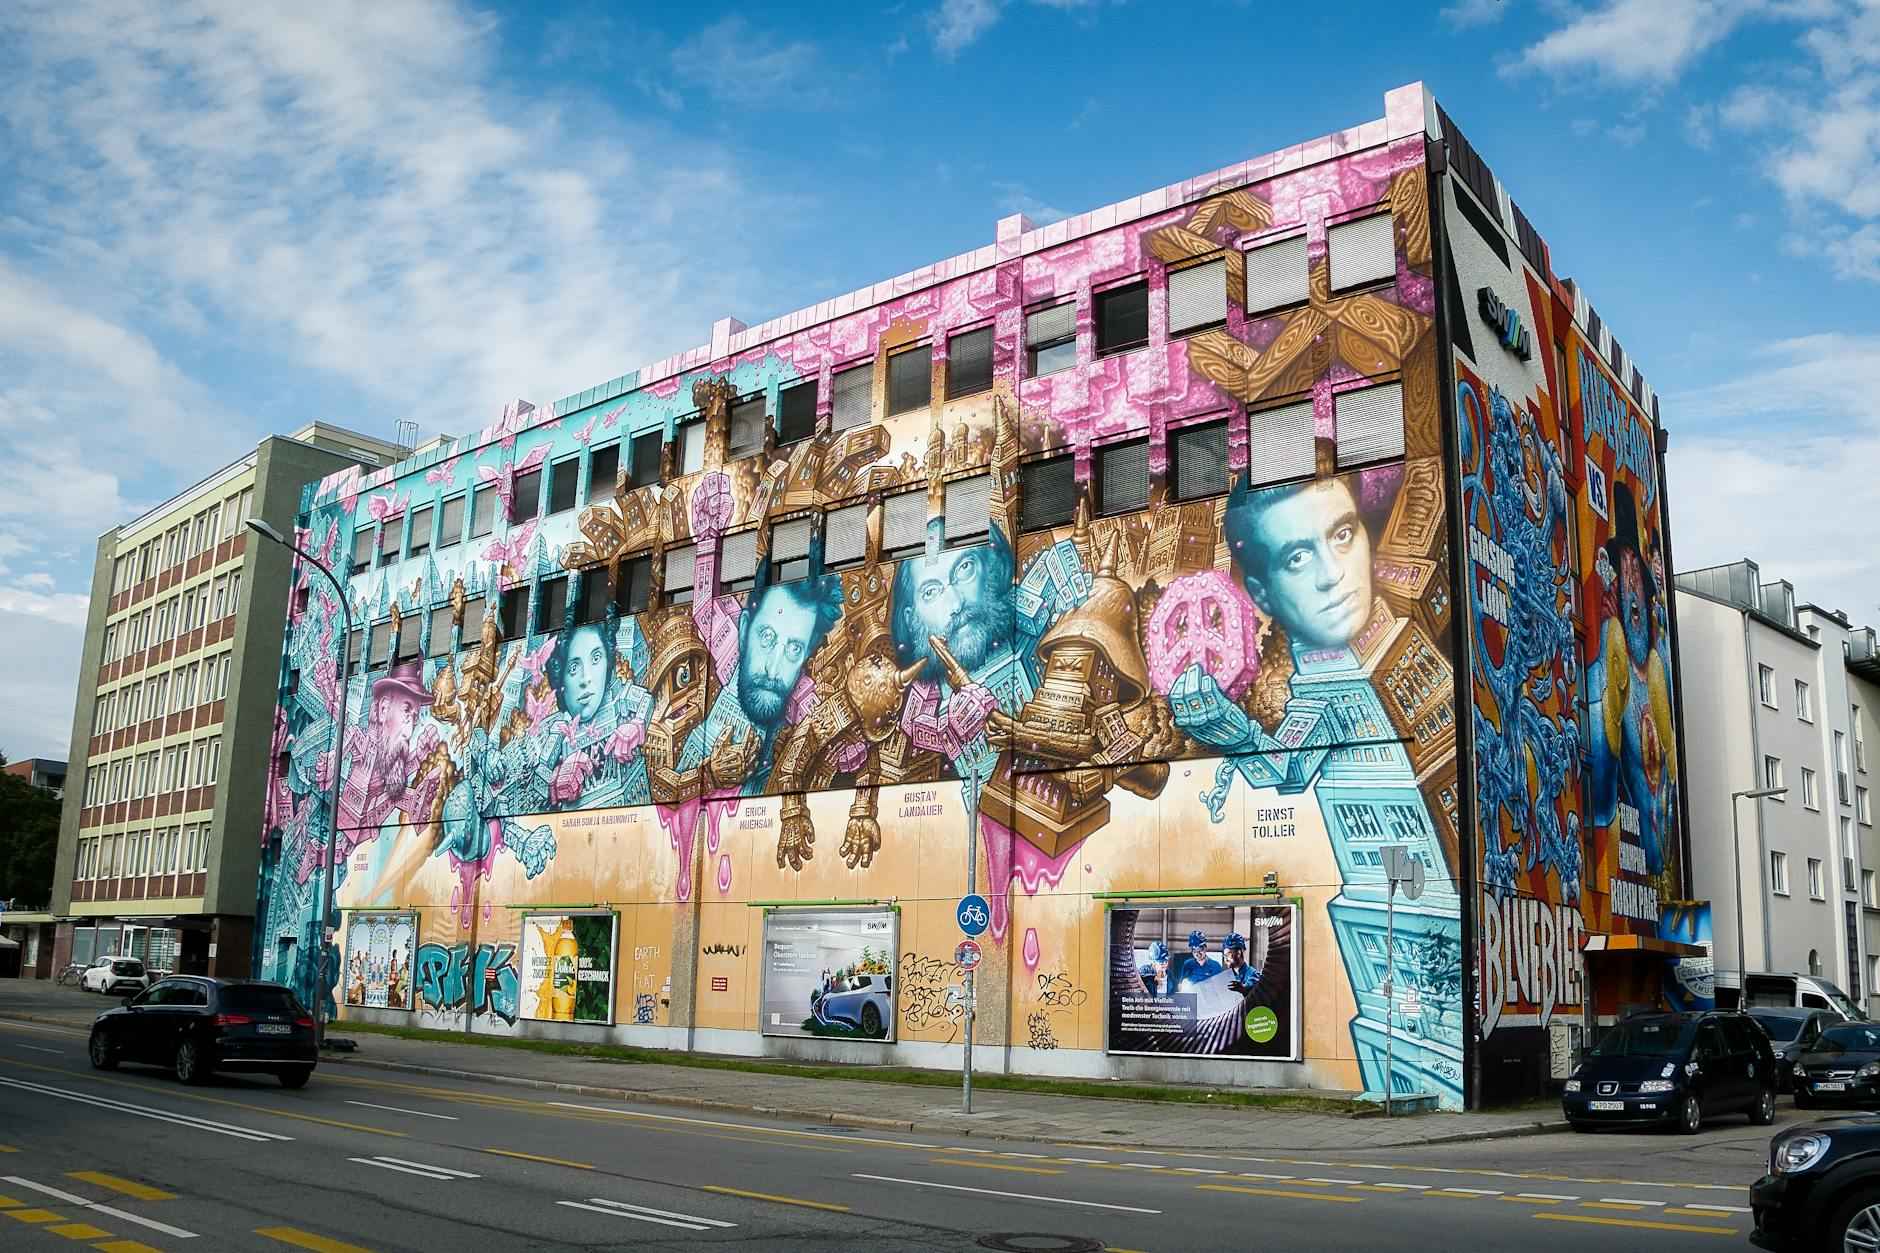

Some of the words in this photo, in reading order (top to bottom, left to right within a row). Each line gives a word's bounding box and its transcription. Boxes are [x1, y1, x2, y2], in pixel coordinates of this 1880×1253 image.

[904, 790, 937, 803] GUSTAV
[745, 806, 767, 817] ERICH
[899, 804, 943, 818] LANDAUER
[1257, 808, 1295, 821] ERNST
[1252, 824, 1295, 838] TOLLER
[1611, 879, 1638, 919] ROBIN
[1638, 885, 1658, 922] PAGE
